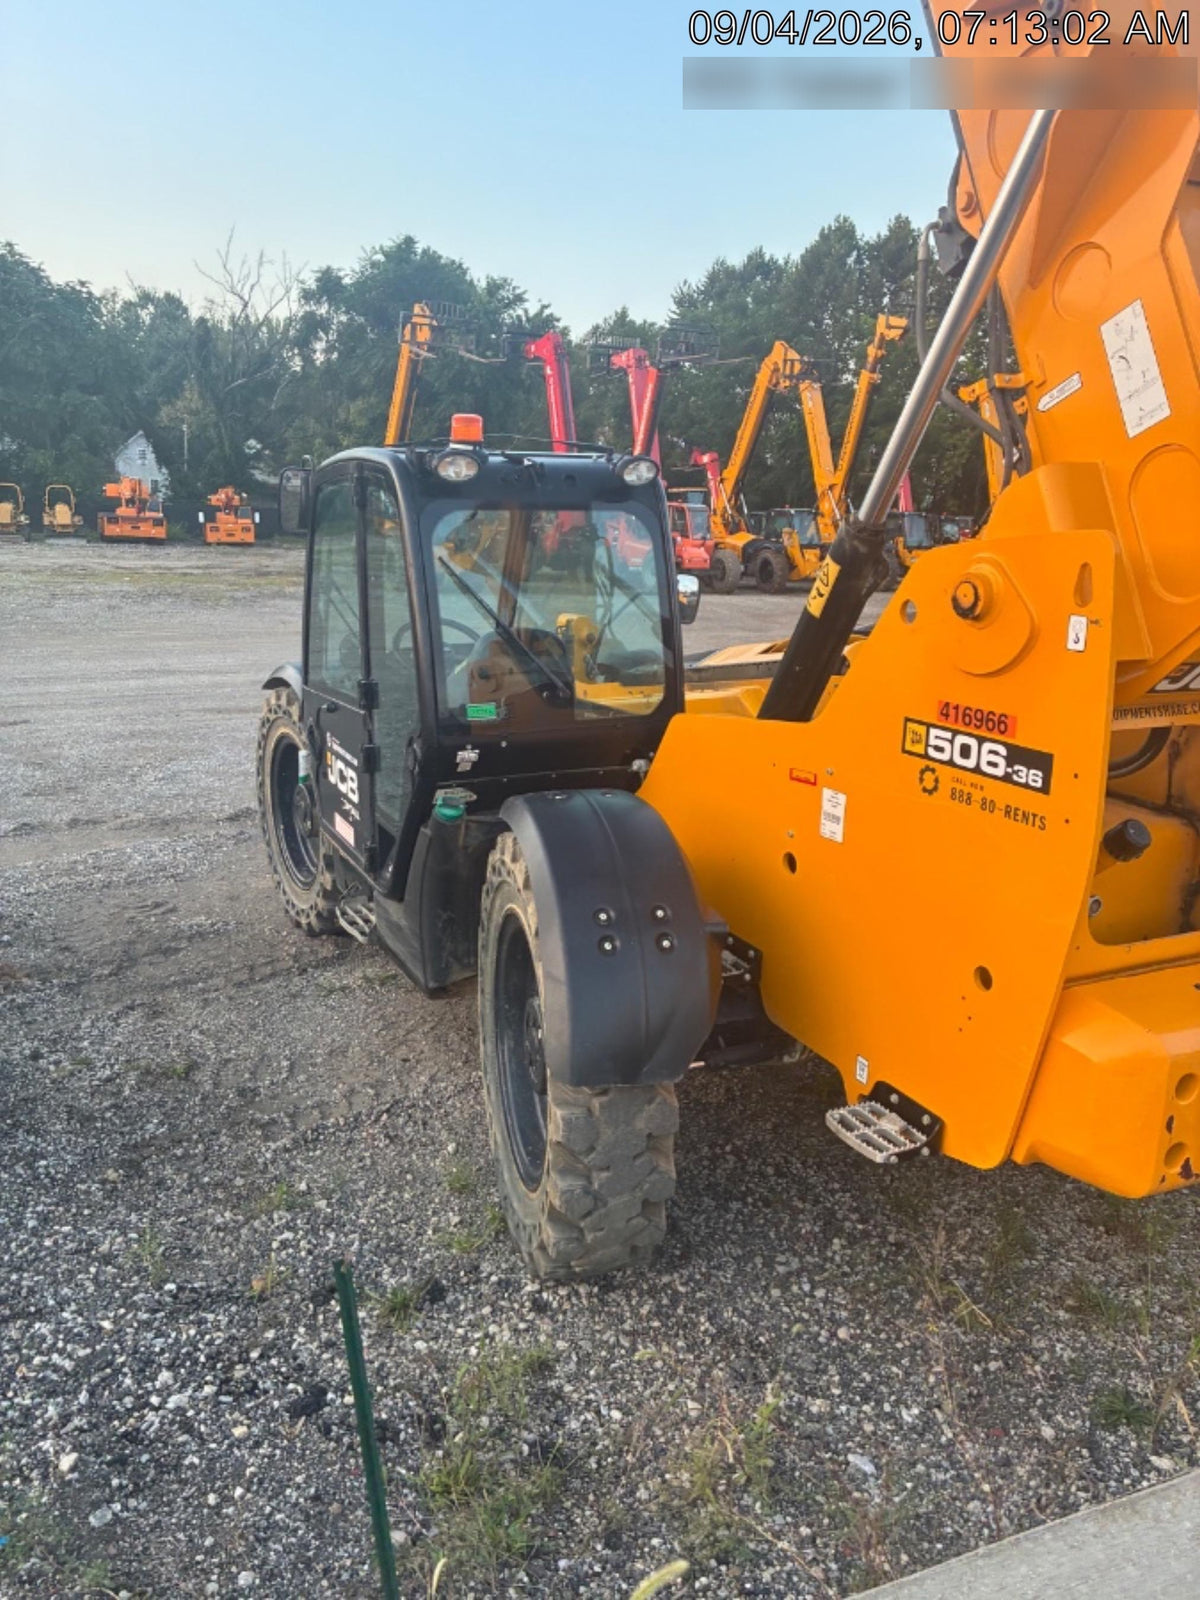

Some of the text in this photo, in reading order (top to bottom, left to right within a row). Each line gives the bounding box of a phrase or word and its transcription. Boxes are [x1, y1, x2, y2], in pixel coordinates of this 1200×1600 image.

[1153, 664, 1200, 691] J
[939, 701, 1009, 735] 416966
[328, 752, 360, 805] JCB
[926, 726, 1044, 789] 506-36
[950, 786, 1047, 831] 888-80-RENTS
